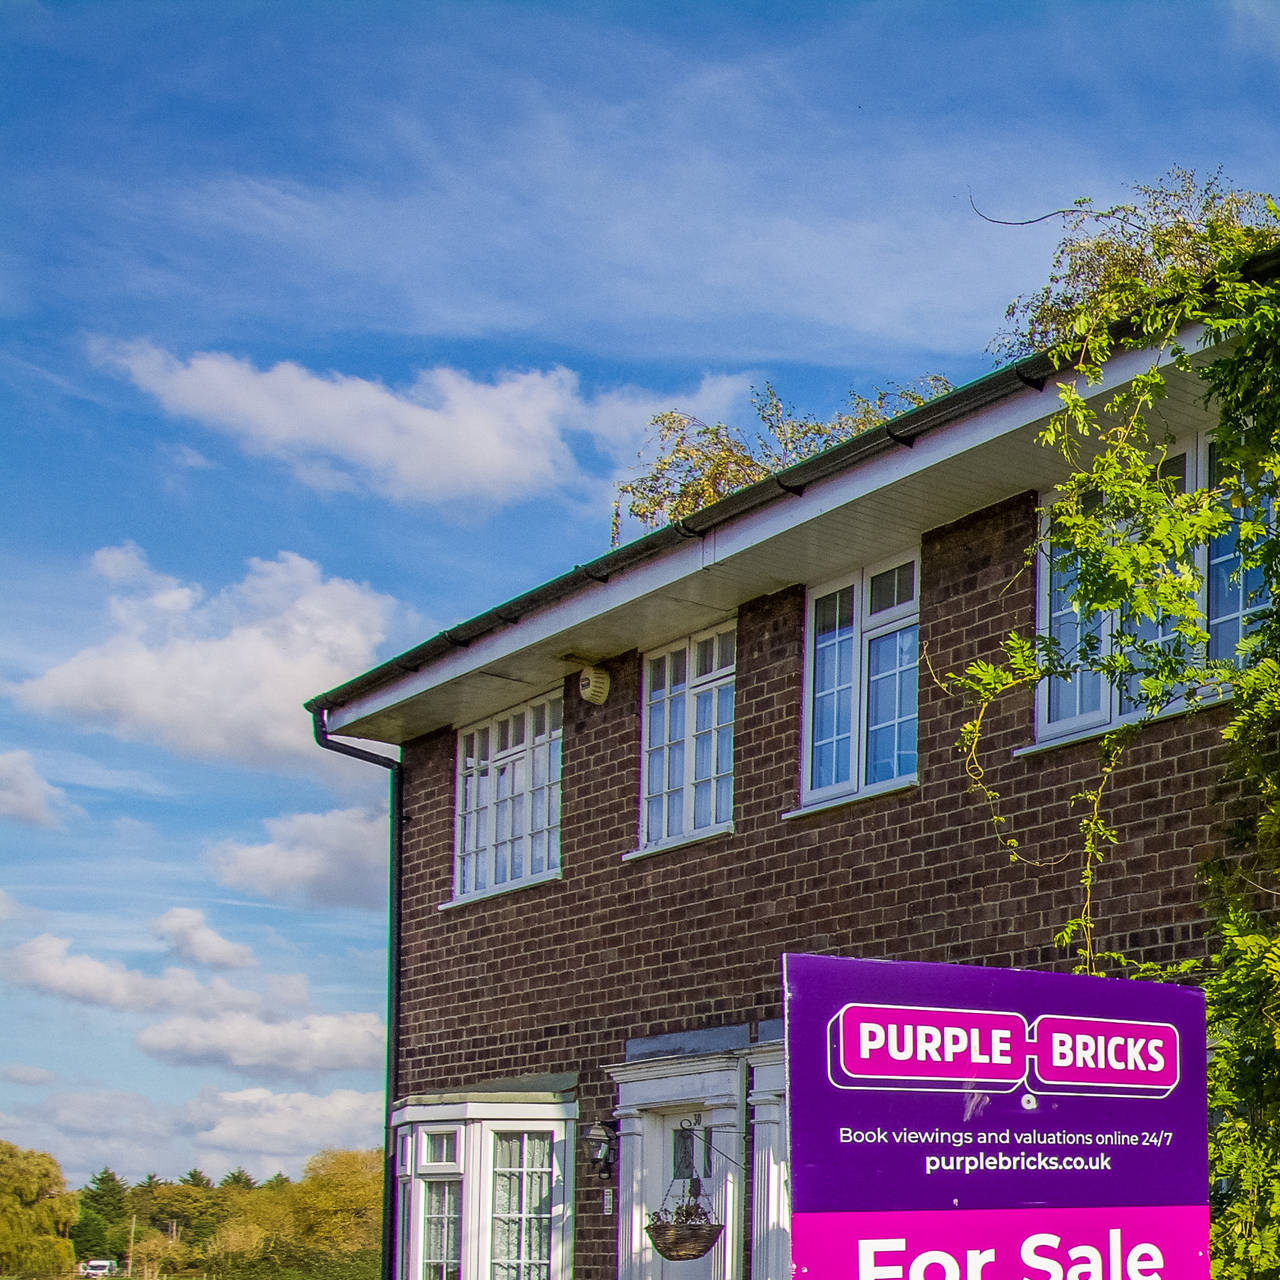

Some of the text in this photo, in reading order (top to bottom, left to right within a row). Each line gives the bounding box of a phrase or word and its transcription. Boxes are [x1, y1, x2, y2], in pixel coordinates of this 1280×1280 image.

[858, 1022, 1165, 1072] PURPLE BRICKS
[839, 1127, 1173, 1147] Book viewings and valuations online 24/7
[925, 1151, 1112, 1175] purplebricks.co.uk
